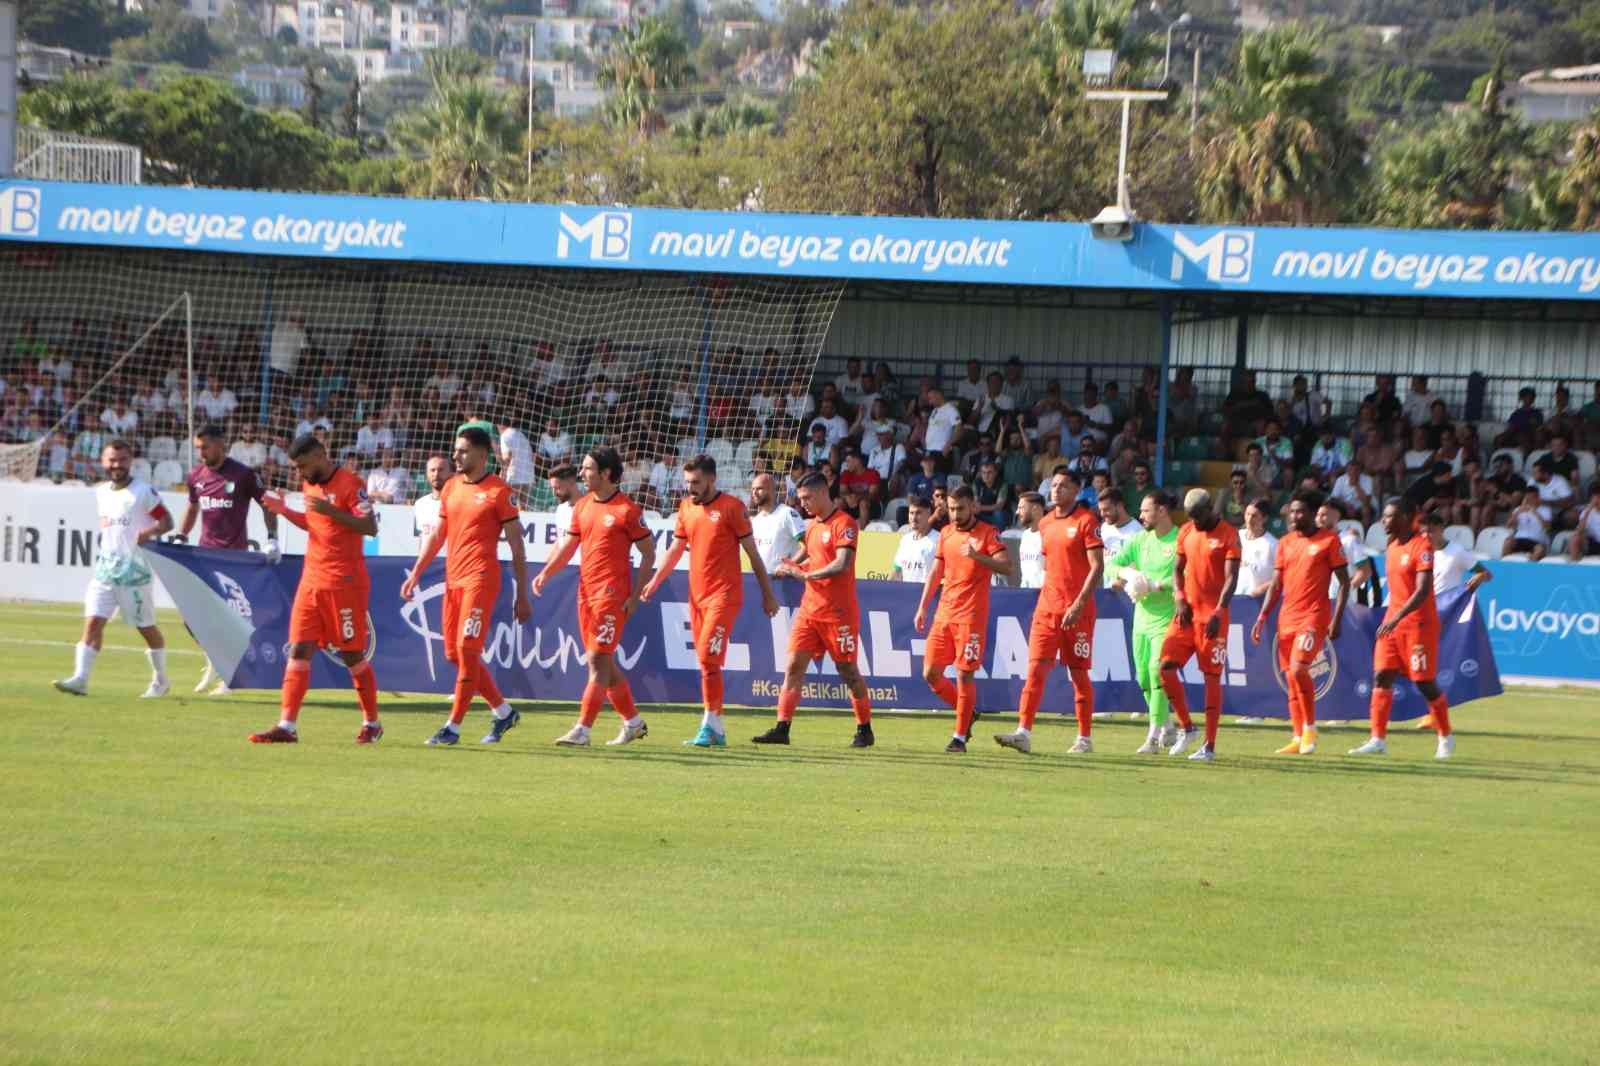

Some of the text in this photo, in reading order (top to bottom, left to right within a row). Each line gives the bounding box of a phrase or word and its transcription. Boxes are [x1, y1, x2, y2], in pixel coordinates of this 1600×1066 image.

[59, 205, 142, 234] mavi
[145, 207, 247, 245] beyaz
[252, 217, 406, 253] akaryakıt
[557, 211, 1012, 272] MB mavi beyaz akaryakıt
[1170, 231, 1255, 283] MB
[1272, 247, 1364, 278] mavi
[1371, 248, 1484, 288] beyaz
[57, 519, 103, 566] İN
[343, 620, 354, 640] 6
[464, 618, 482, 639] 80
[596, 625, 615, 645] 23
[709, 635, 723, 657] 14
[836, 635, 855, 654] 75
[963, 643, 981, 662] 53
[1074, 643, 1090, 660] 69
[1296, 632, 1314, 652] 10
[1210, 645, 1226, 666] 30
